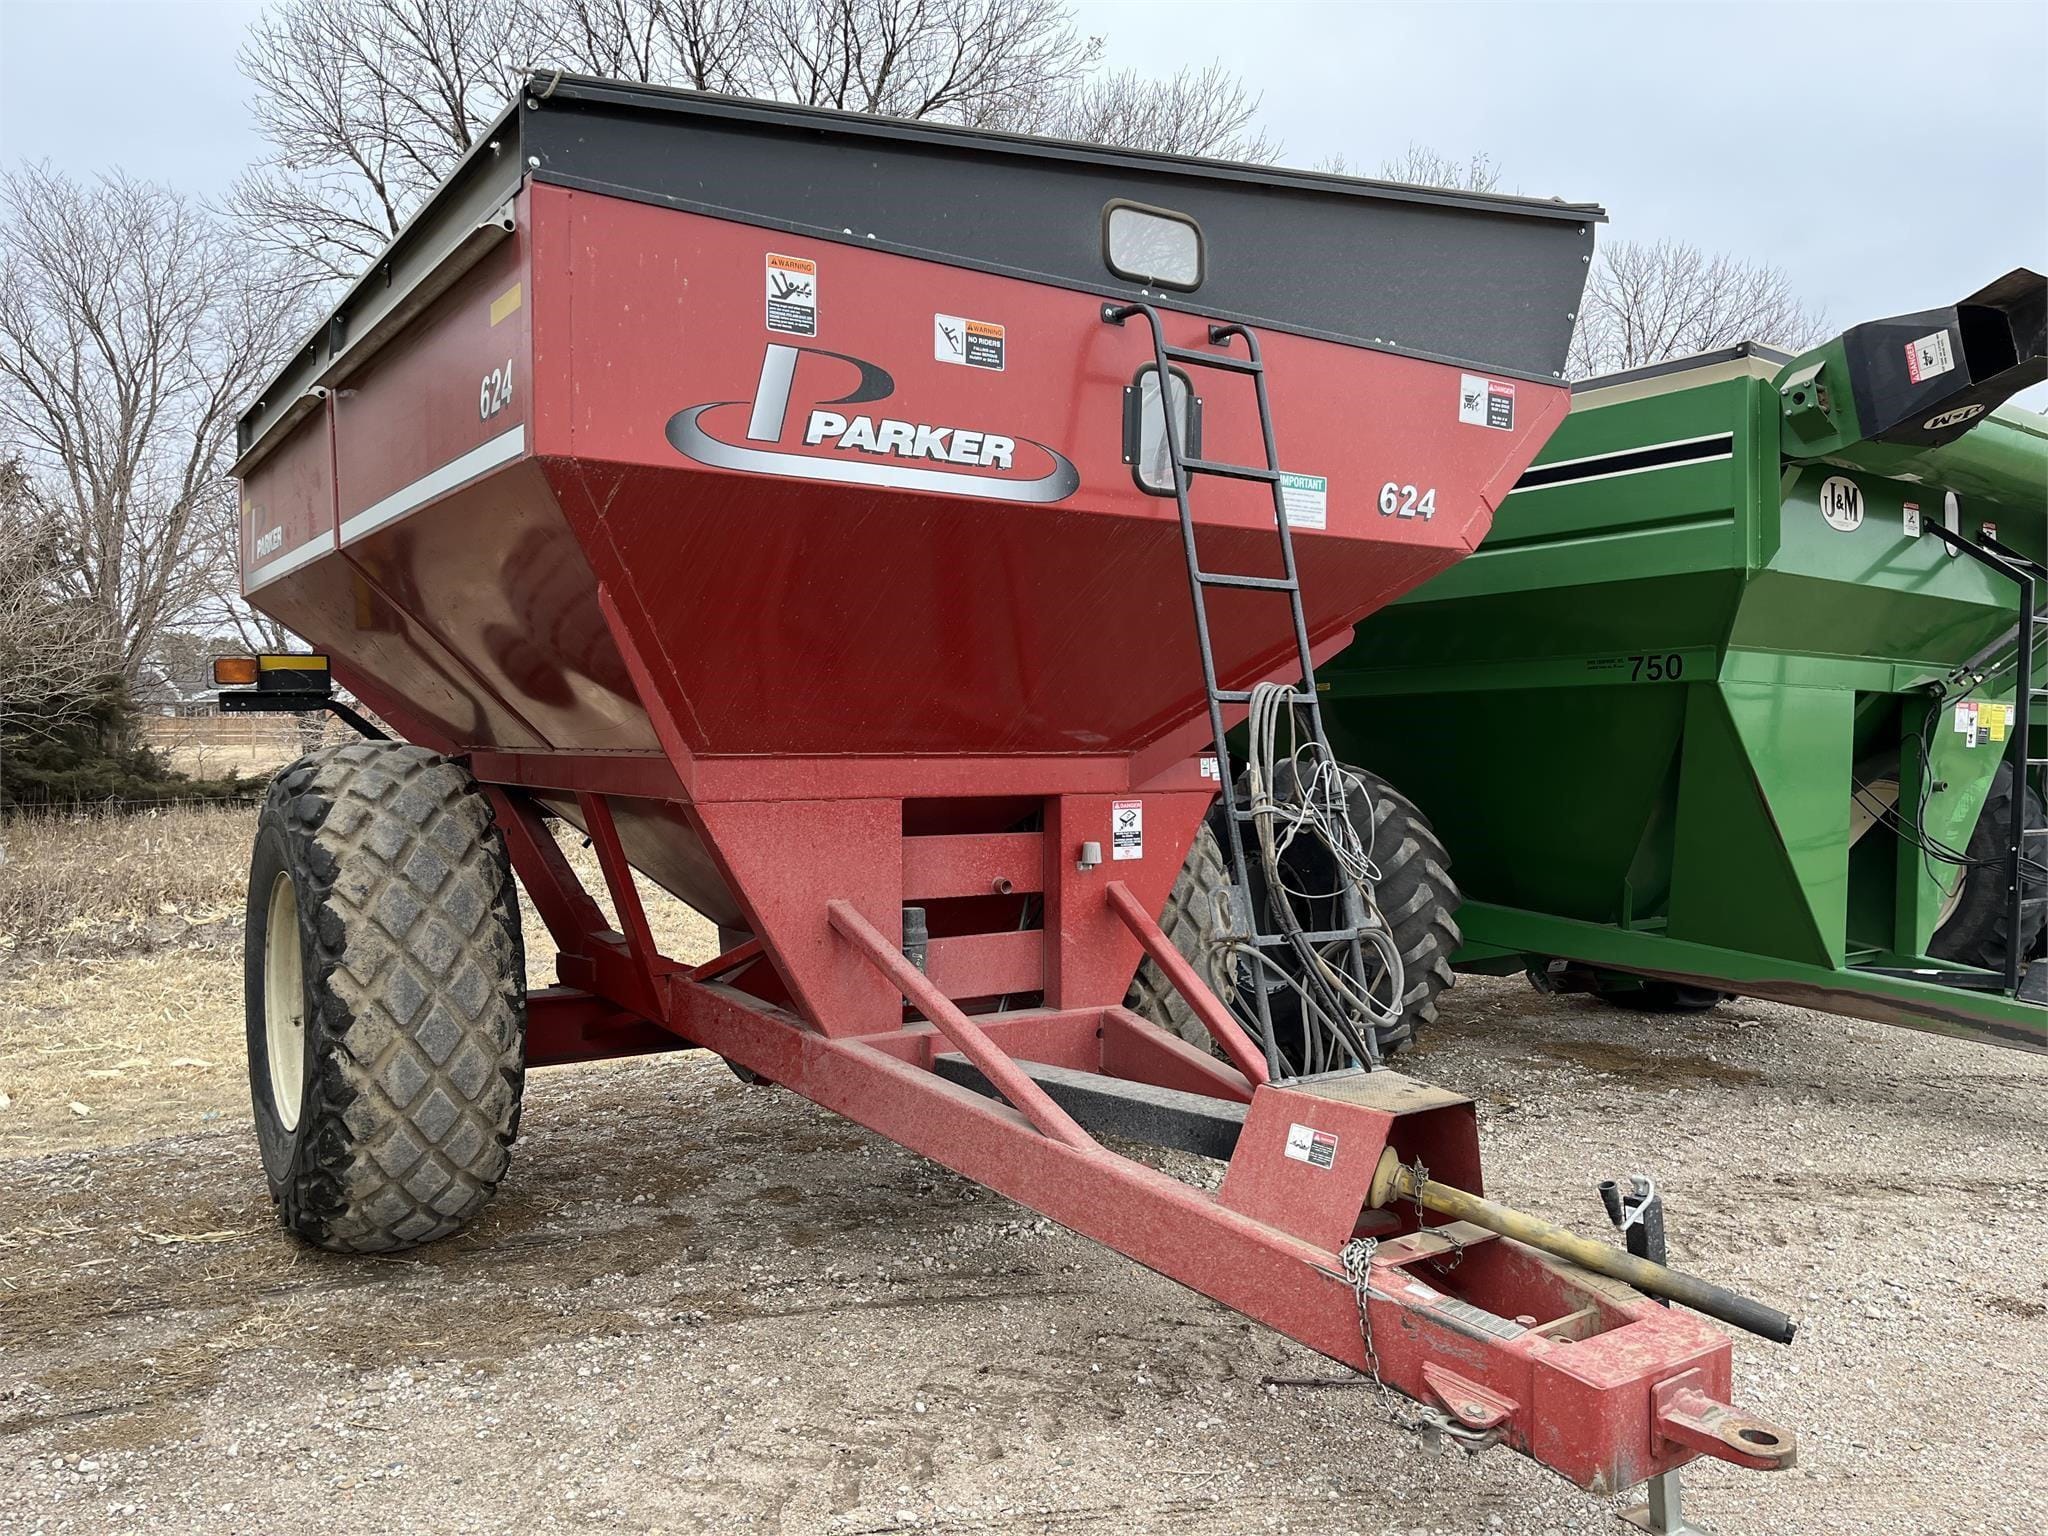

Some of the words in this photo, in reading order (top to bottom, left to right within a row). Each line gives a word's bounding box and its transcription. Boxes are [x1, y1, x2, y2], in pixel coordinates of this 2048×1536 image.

[778, 260, 812, 272] WARNING
[974, 325, 1002, 336] WARNING
[979, 338, 1000, 347] RIDERS
[1906, 343, 1919, 375] DANGER
[480, 358, 512, 422] 624
[803, 410, 1017, 469] PARKER
[1280, 474, 1323, 490] IMPORTANT
[1379, 482, 1437, 520] 624
[1824, 482, 1859, 523] J&M
[256, 525, 282, 559] PARKER
[1628, 653, 1683, 682] 750
